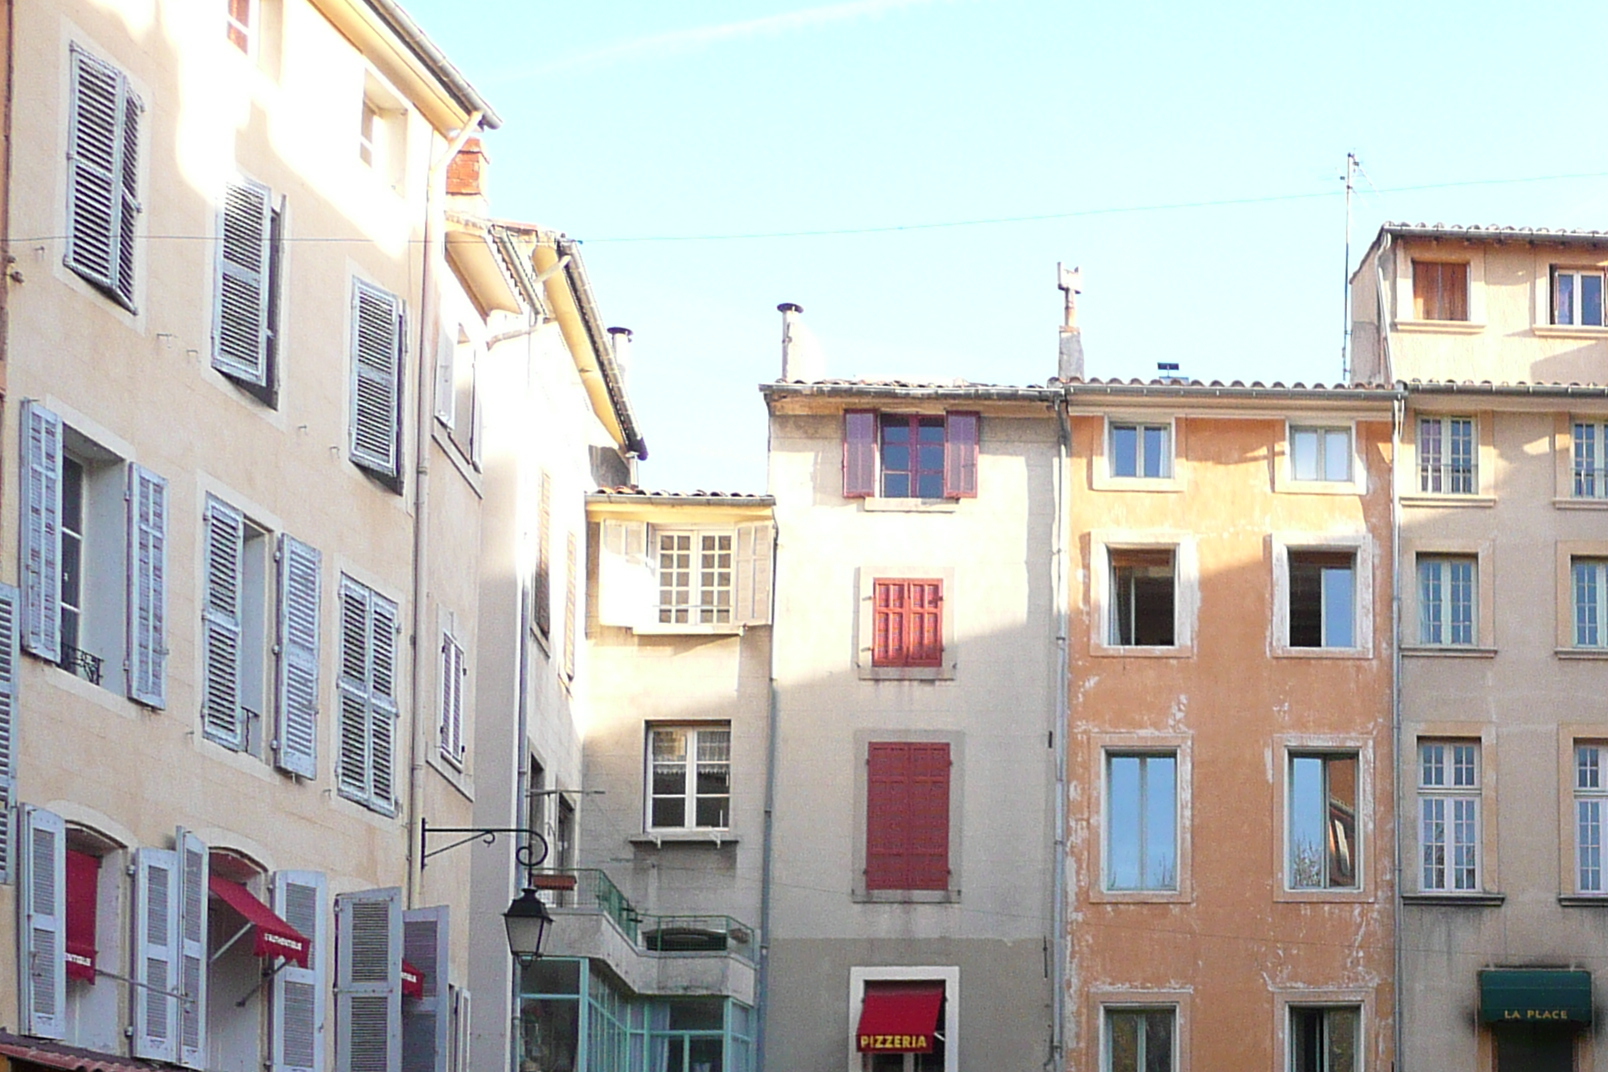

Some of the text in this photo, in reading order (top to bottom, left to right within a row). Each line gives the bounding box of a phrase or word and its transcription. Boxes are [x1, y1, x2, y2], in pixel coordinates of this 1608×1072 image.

[1504, 1010, 1568, 1019] LA PLACE
[860, 1035, 927, 1049] PIZZERIA
